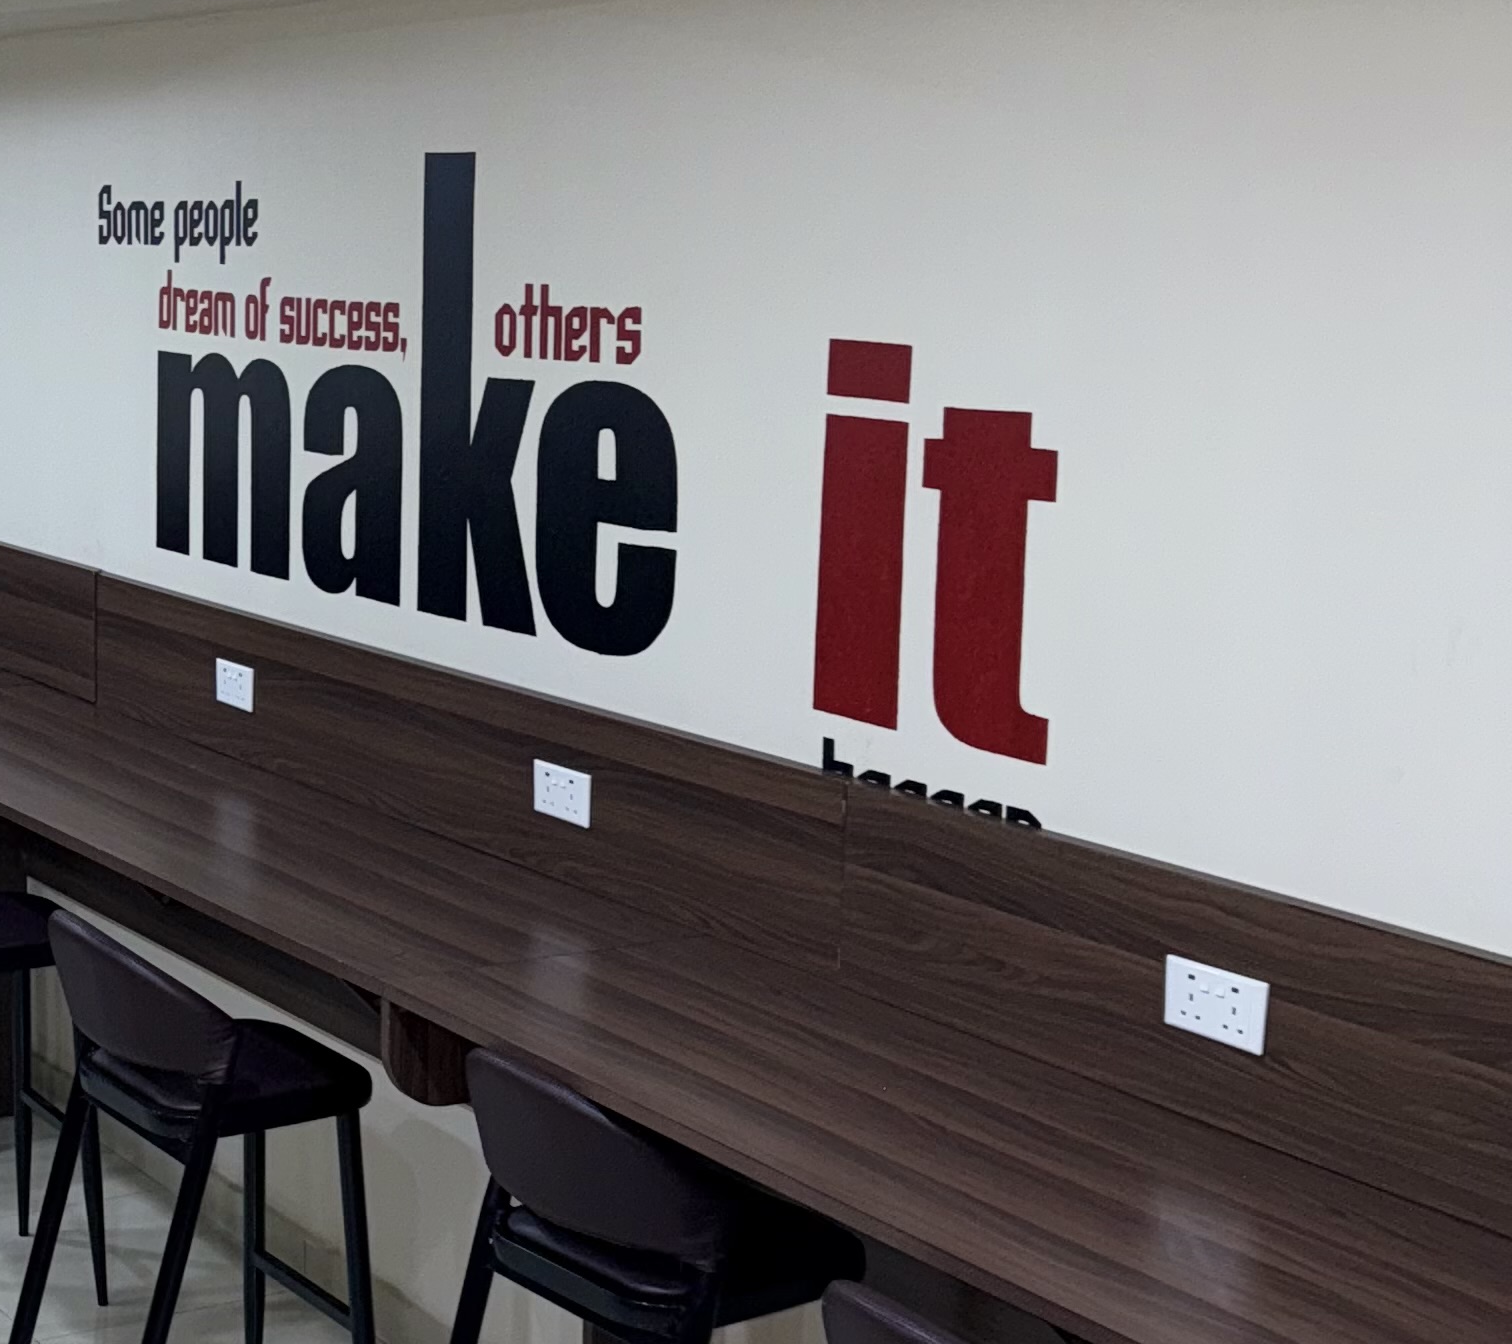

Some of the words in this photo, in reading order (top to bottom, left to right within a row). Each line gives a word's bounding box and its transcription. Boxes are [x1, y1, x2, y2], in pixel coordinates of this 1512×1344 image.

[98, 184, 165, 246] Some
[173, 180, 259, 265] people
[158, 269, 236, 339] dream
[244, 276, 272, 341] of
[279, 296, 408, 362] success,
[494, 283, 642, 365] others
[156, 151, 678, 657] make
[812, 338, 1059, 766] it
